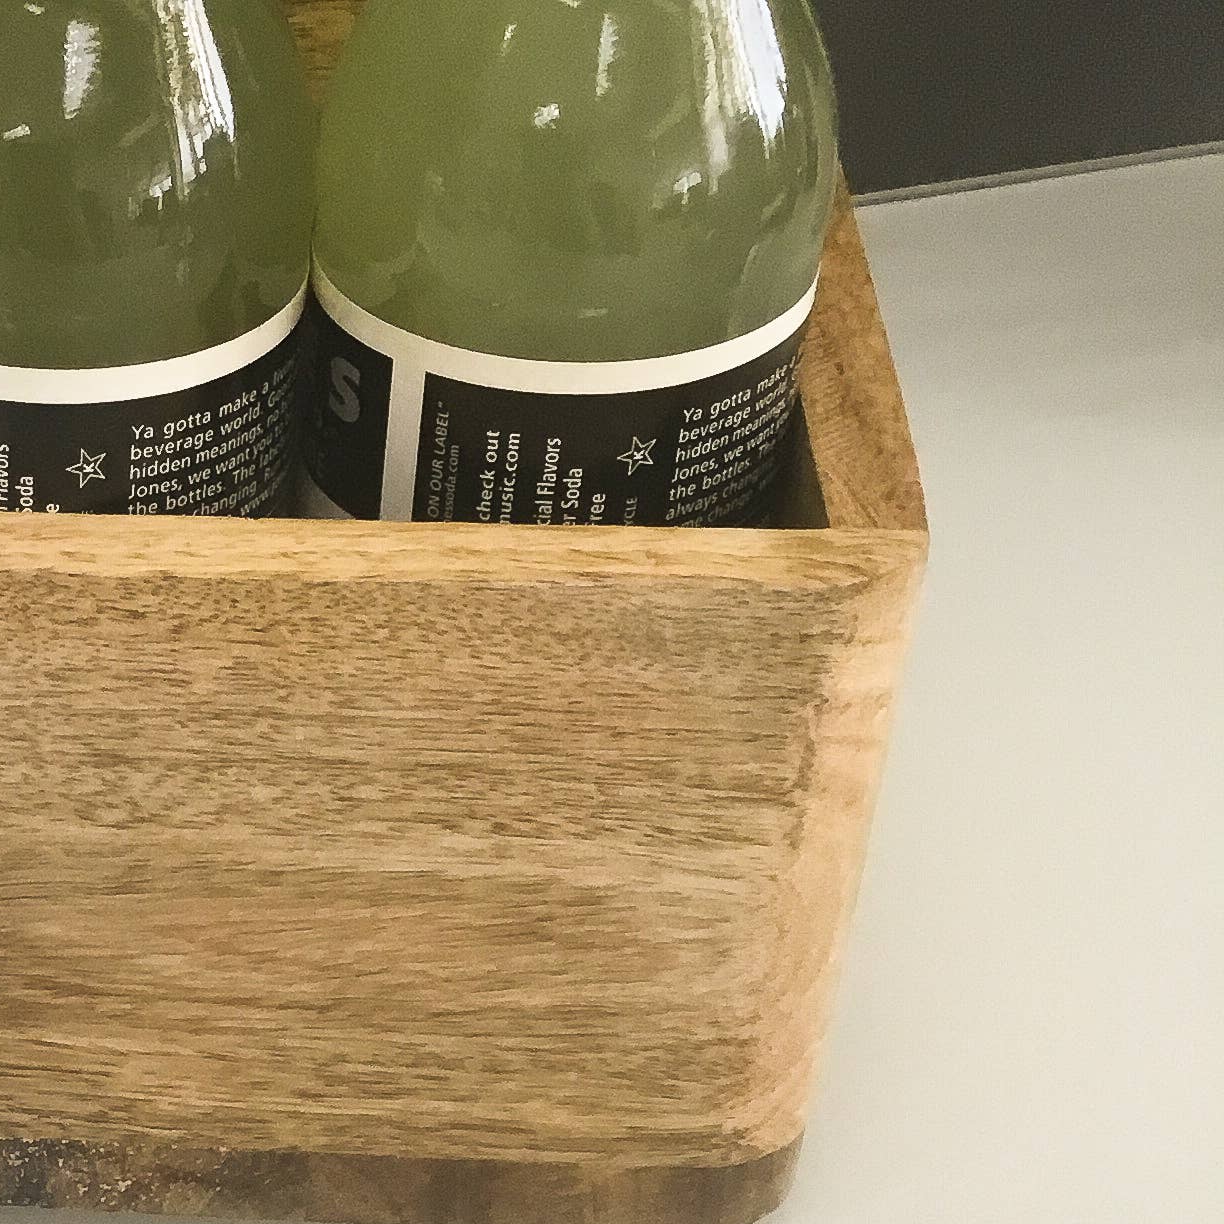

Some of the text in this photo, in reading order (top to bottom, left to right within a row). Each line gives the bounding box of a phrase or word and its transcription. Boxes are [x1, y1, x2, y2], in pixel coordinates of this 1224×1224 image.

[131, 424, 154, 440] Ya
[163, 411, 211, 439] gotta
[218, 389, 257, 418] make
[261, 381, 269, 395] a
[678, 405, 751, 444] beverage
[683, 408, 703, 423] Ya
[710, 388, 751, 419] gotta
[130, 429, 214, 461] beverage
[671, 457, 719, 484] Jones,
[723, 445, 744, 463] we
[675, 434, 729, 463] hidden
[128, 478, 183, 500] Jones,
[188, 467, 211, 484] we
[215, 448, 251, 475] want
[252, 434, 273, 459] you
[129, 457, 191, 480] hidden
[429, 460, 445, 491] OUR
[476, 430, 501, 521] check out
[536, 436, 562, 496] Flavors
[127, 501, 158, 515] the
[232, 464, 256, 484] The
[560, 468, 583, 509] Soda
[665, 491, 718, 521] always
[669, 483, 697, 501] the
